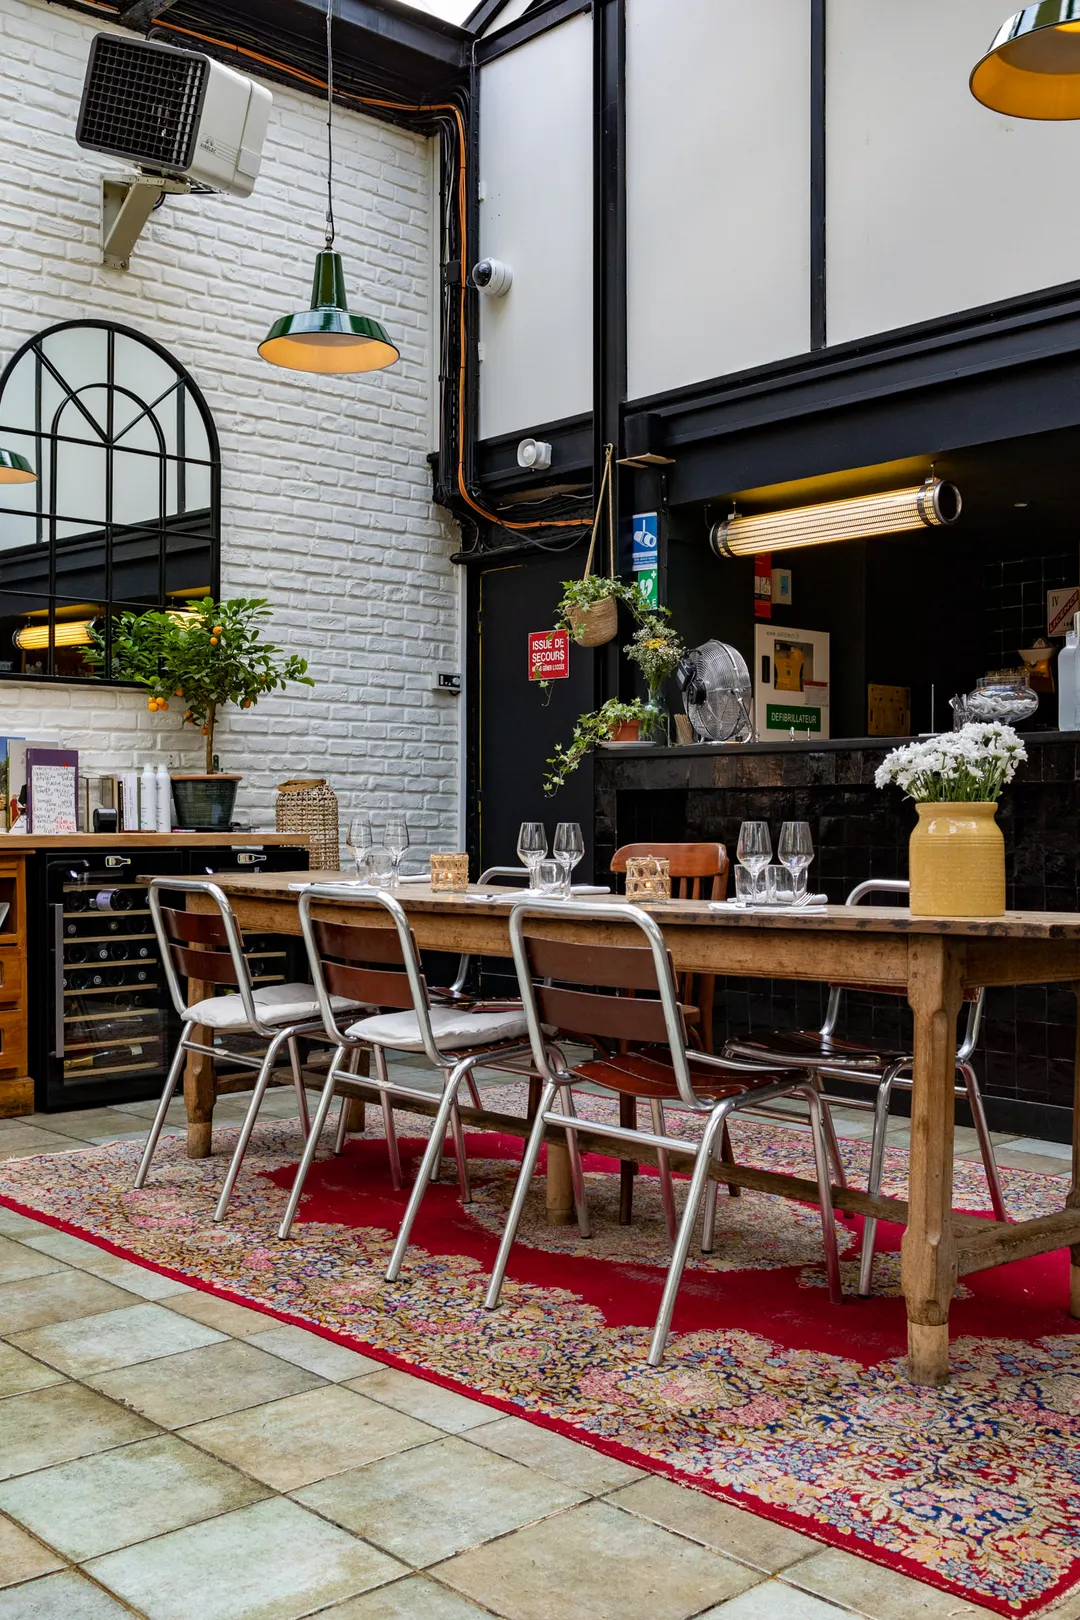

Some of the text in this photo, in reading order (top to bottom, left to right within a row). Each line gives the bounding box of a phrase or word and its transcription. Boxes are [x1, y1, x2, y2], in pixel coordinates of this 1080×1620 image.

[532, 638, 564, 650] ISSUE DE
[532, 650, 565, 662] SECOURS
[771, 712, 816, 724] DEFIBRILLATEUR
